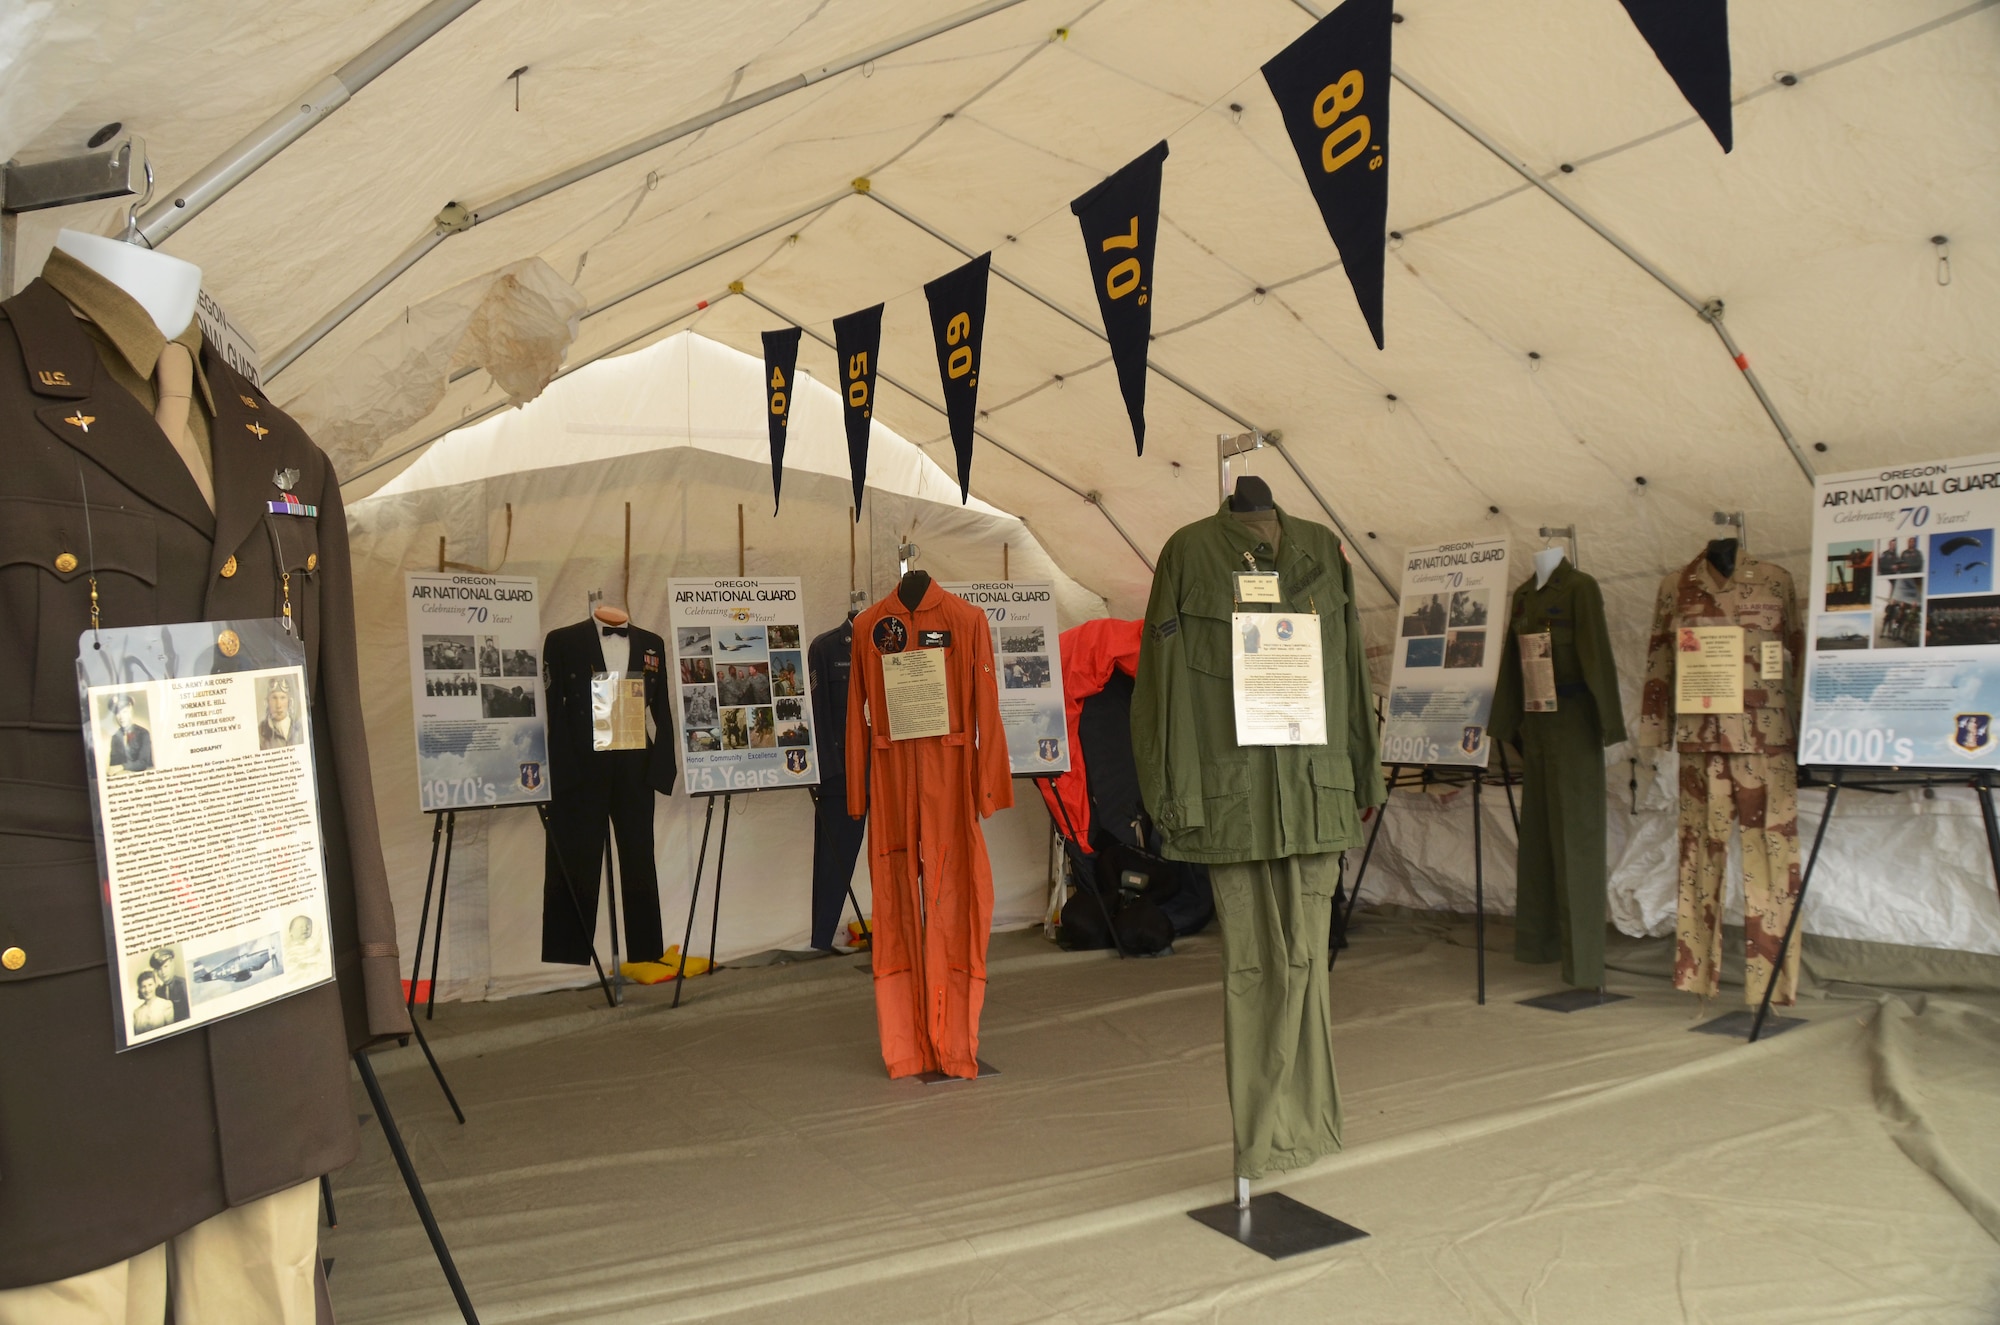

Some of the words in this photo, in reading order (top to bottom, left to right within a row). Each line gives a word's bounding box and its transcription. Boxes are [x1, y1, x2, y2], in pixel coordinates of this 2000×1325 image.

[1313, 69, 1383, 173] 80's
[1102, 215, 1147, 306] 70's
[198, 289, 227, 330] EGON
[947, 312, 976, 387] 60's
[849, 351, 870, 418] 50's
[771, 366, 786, 426] 40's
[1880, 465, 1947, 482] OREGON
[1823, 491, 1848, 507] AIR
[1851, 480, 1938, 504] NATIONAL
[1942, 472, 2000, 494] GUARD
[1834, 510, 1895, 524] Celebrating
[1897, 506, 1930, 530] 70
[1935, 511, 1970, 525] Years!
[1439, 542, 1474, 552] OREGON
[1408, 559, 1422, 571] AIR
[1423, 553, 1468, 569] NATIONAL
[1470, 549, 1505, 563] GUARD
[453, 576, 496, 585] OREGON
[1445, 572, 1463, 589] 70
[412, 586, 431, 598] AIR
[434, 587, 492, 600] NATIONAL
[494, 589, 532, 602] GUARD
[676, 591, 694, 602] AIR
[696, 591, 755, 602] NATIONAL
[757, 590, 796, 600] GUARD
[1012, 592, 1050, 602] GUARD
[422, 603, 466, 616] Celebrating
[467, 606, 488, 623] 70
[492, 615, 512, 623] Years!
[685, 606, 728, 617] Celebrating
[755, 614, 775, 622] Years!
[986, 608, 1006, 621] 70
[193, 688, 227, 698] LIEUTENANT
[174, 730, 202, 738] EUROPEAN
[190, 745, 222, 753] BIOGRAPHY
[748, 752, 777, 760] Excellence
[1385, 736, 1439, 762] 1990's
[1805, 728, 1914, 764] 2000's
[687, 768, 713, 791] 75
[718, 766, 780, 789] Years
[423, 777, 497, 807] 1970's
